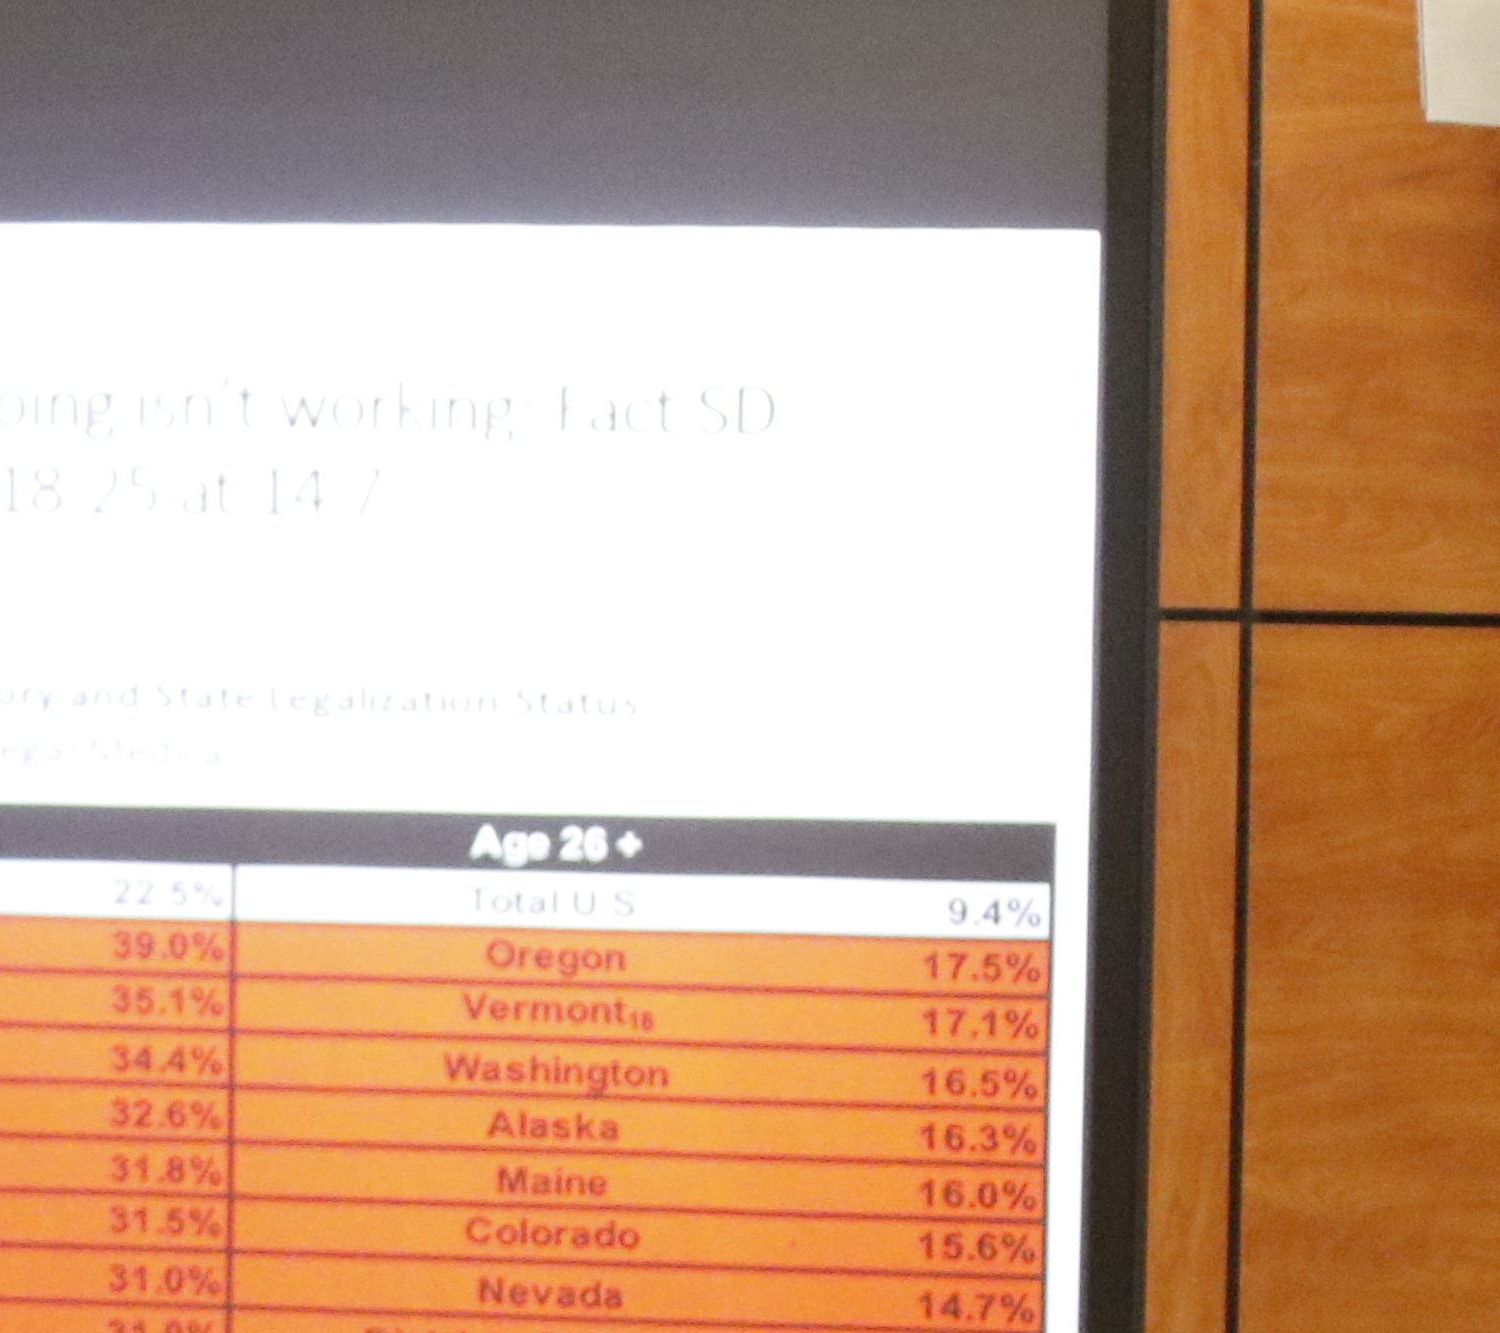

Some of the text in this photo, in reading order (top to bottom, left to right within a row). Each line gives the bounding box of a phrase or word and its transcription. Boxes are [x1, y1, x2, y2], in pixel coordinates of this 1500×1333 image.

[557, 383, 676, 434] Fact
[698, 384, 777, 436] SD
[180, 471, 232, 515] at
[68, 681, 141, 709] and
[469, 824, 551, 868] Age
[559, 825, 608, 862] 26
[114, 878, 225, 909] 22.5%
[947, 896, 1043, 929] 9.4%
[112, 929, 226, 961] 39.0%
[486, 939, 1042, 984] Oregon 17.5%
[111, 986, 226, 1016] 35.1%
[921, 1007, 1040, 1040] 17.1%
[110, 1045, 224, 1077] 34.4%
[443, 1051, 1038, 1101] Washington 16.5%
[109, 1098, 223, 1130] 32.6%
[487, 1109, 1038, 1156] Alaska 16.3%
[109, 1154, 223, 1186] 31.8%
[496, 1165, 1038, 1212] Maine 16.0%
[108, 1206, 222, 1238] 31.5%
[465, 1216, 1037, 1264] Colorado 15.6%
[108, 1263, 221, 1296] 31.0%
[476, 1276, 1036, 1325] Nevada 14.7%
